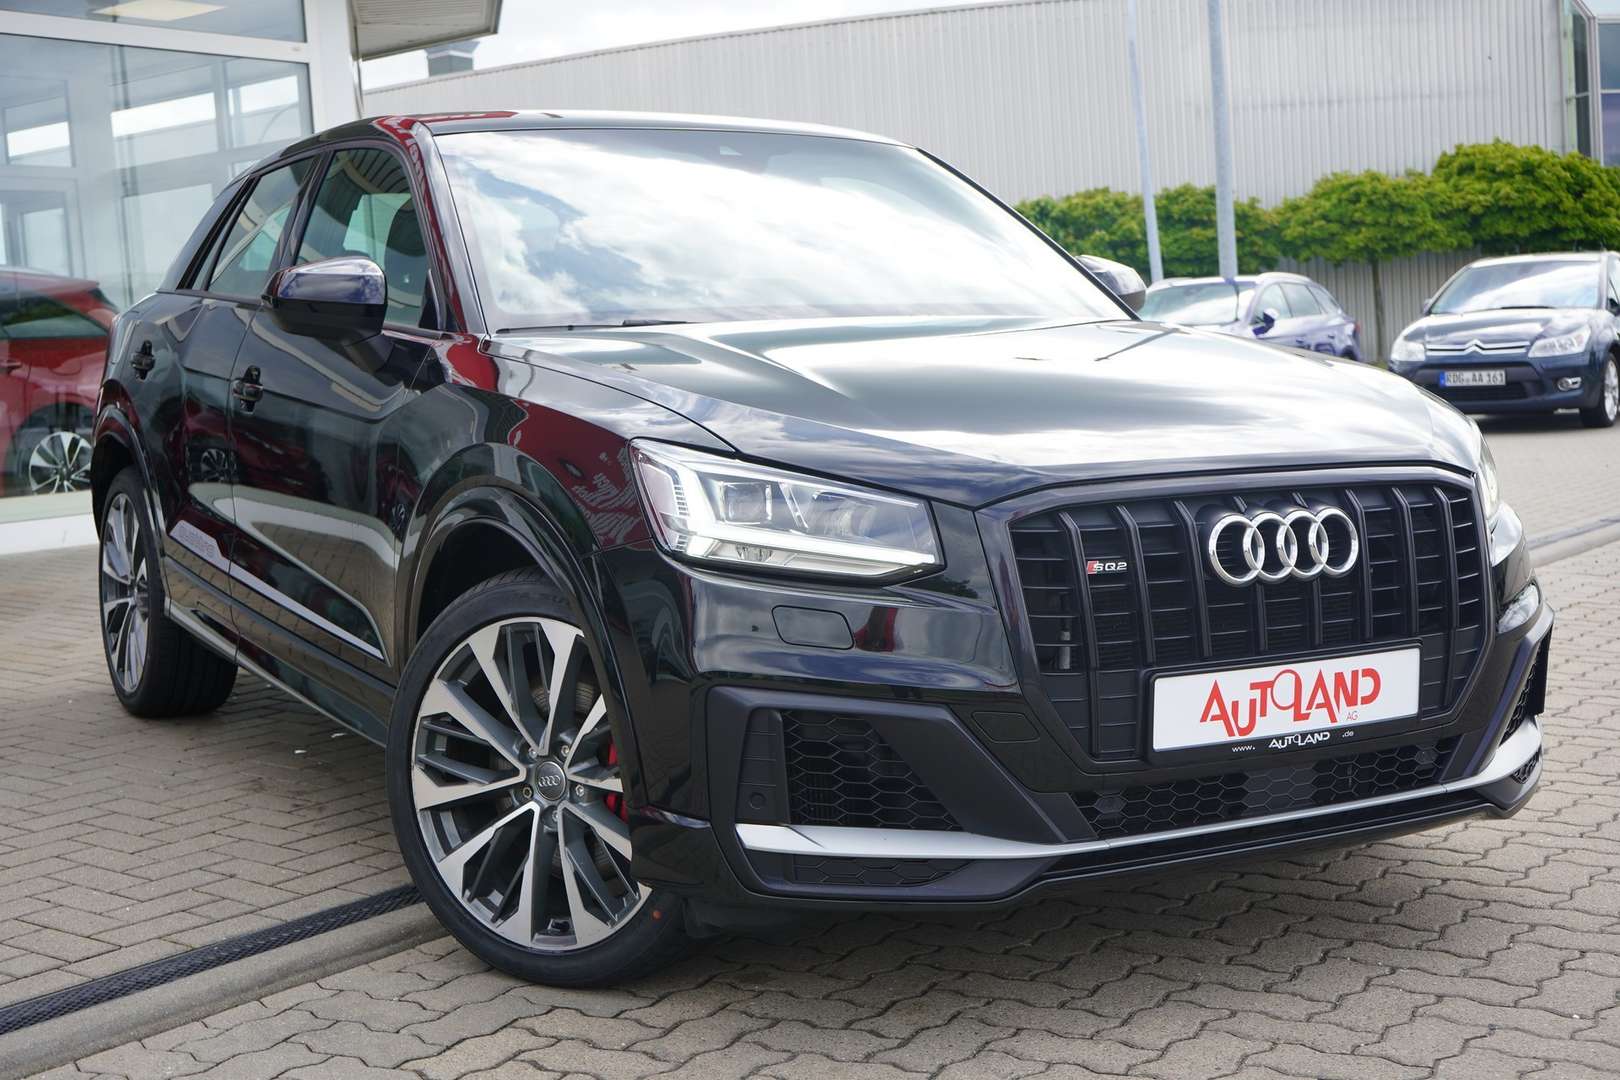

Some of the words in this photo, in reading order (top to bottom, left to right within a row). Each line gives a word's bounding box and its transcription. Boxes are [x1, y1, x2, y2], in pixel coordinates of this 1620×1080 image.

[1472, 373, 1483, 383] AA
[1092, 561, 1127, 572] SQ2
[1199, 668, 1381, 737] AUTOLAND
[1346, 711, 1359, 721] AG
[1231, 744, 1256, 753] www.
[1268, 731, 1331, 748] AUTOLAND
[1341, 730, 1354, 738] .de
